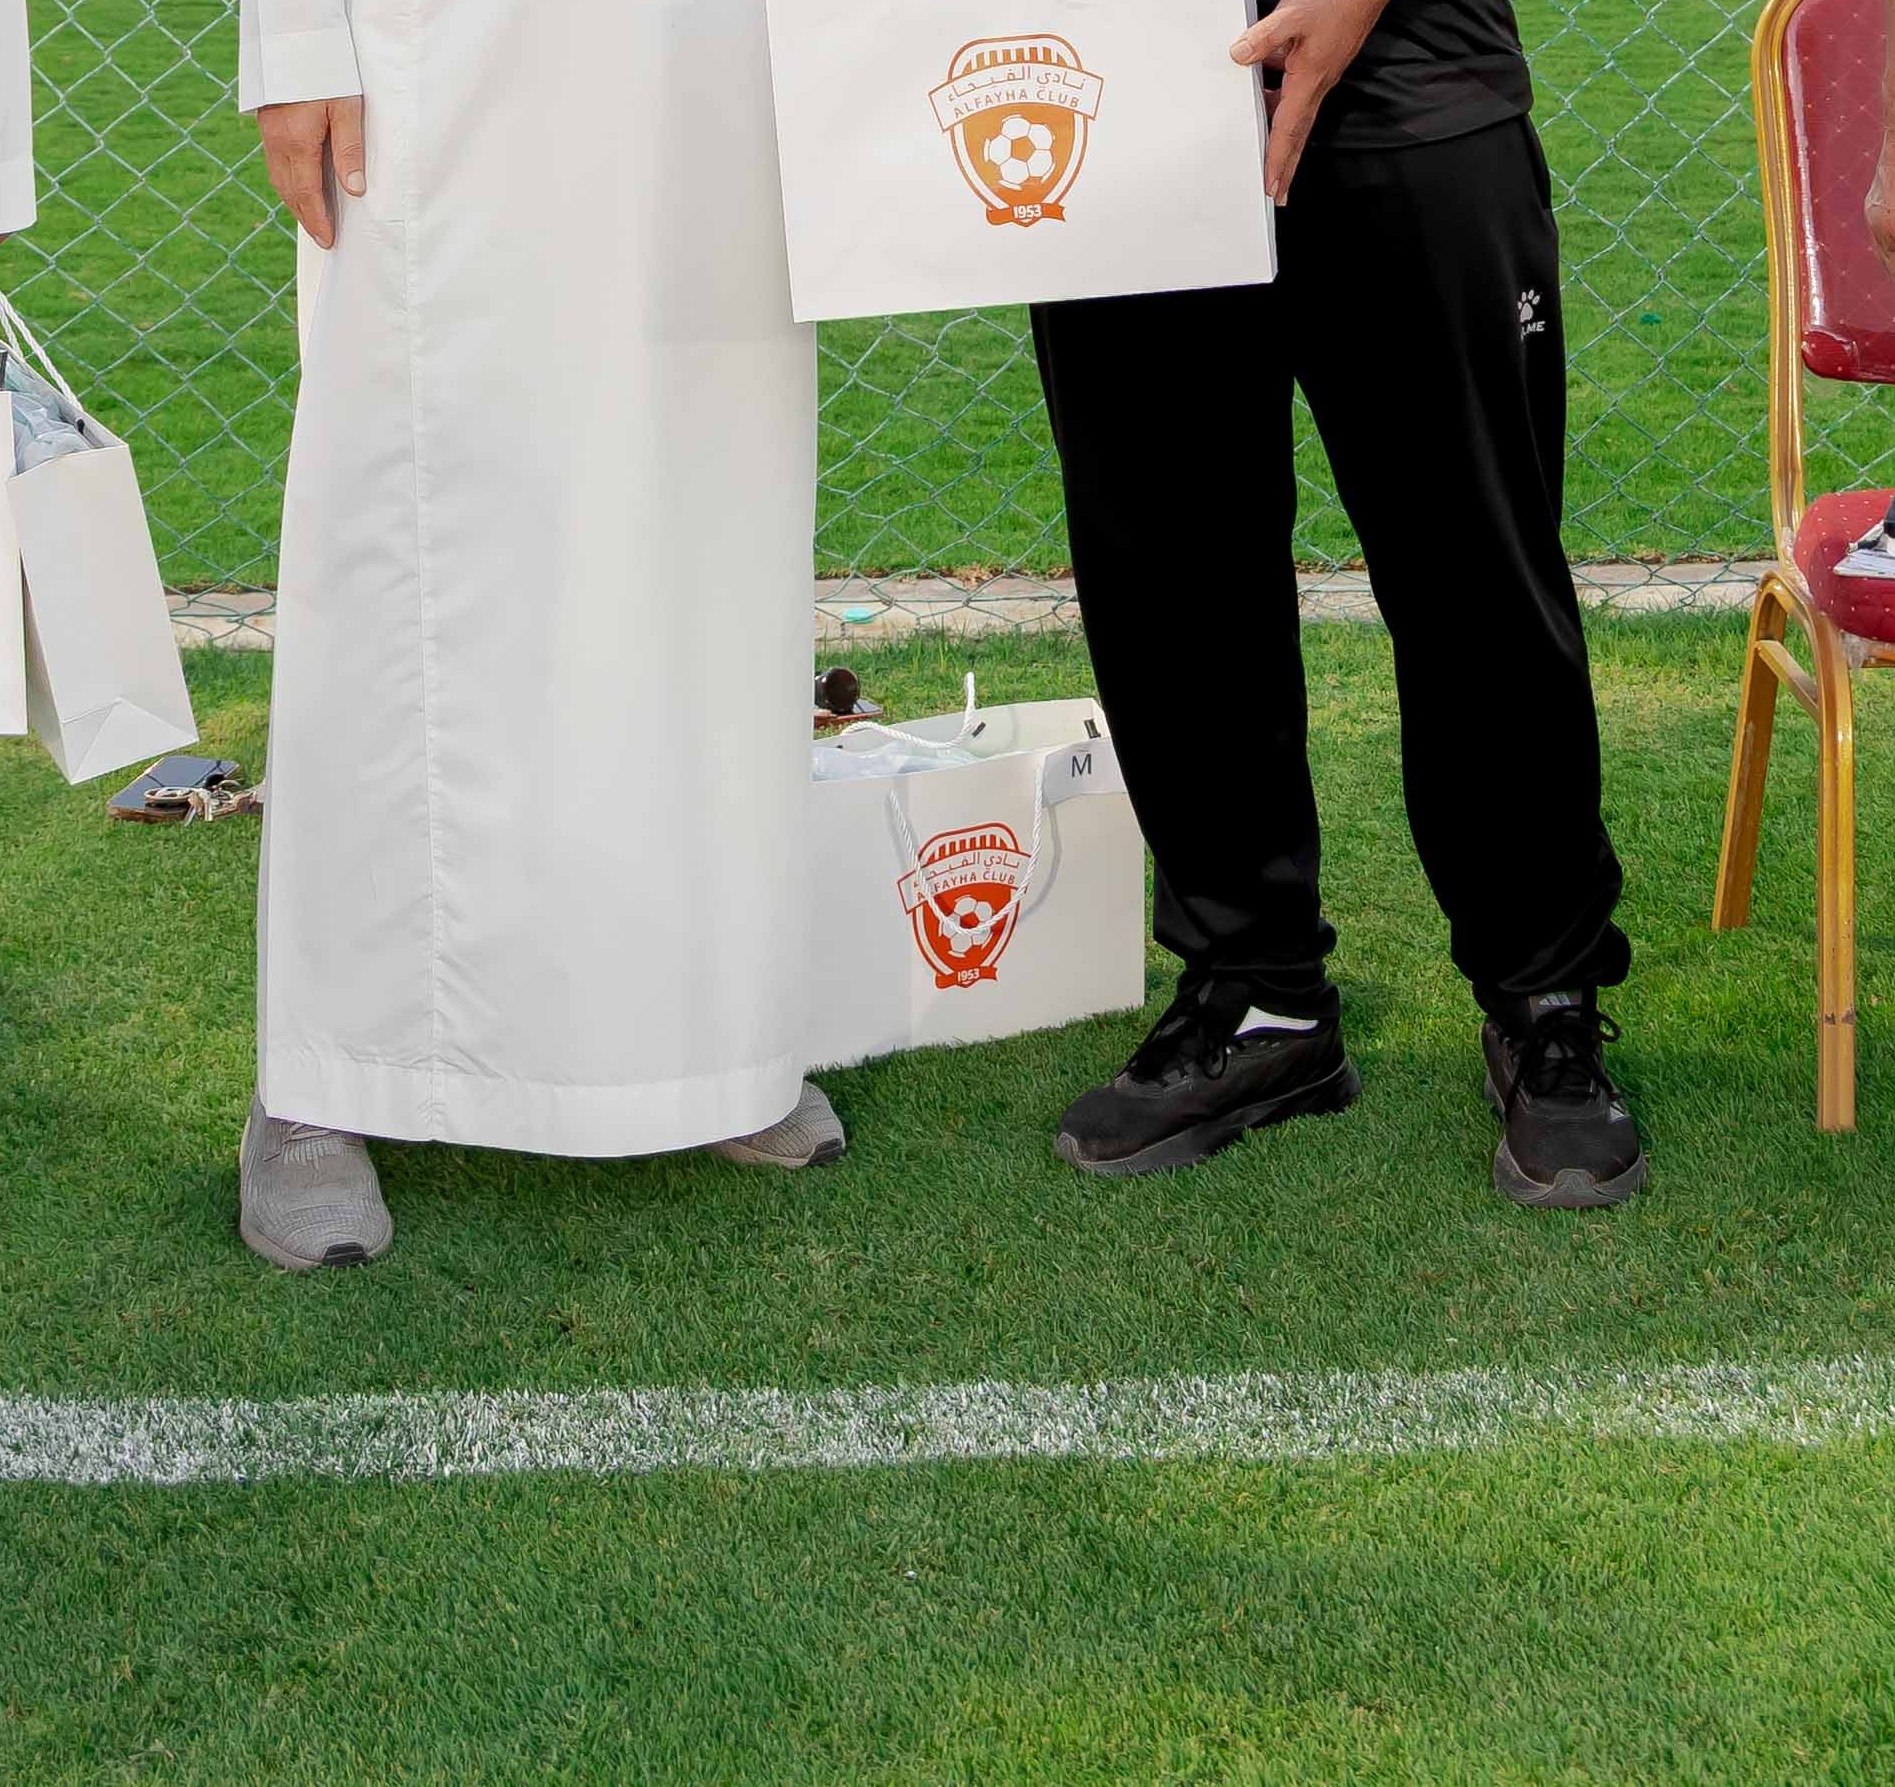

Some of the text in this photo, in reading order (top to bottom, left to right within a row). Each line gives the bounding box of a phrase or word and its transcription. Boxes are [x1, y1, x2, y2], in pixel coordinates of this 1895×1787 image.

[947, 65, 1087, 102] نادي الفيحاء
[954, 88, 1080, 119] ALFAYHA CLUB
[1013, 205, 1043, 220] 1953
[1070, 753, 1093, 778] M
[917, 870, 1016, 901] AFAYHA CLUB
[957, 968, 981, 981] 1953
